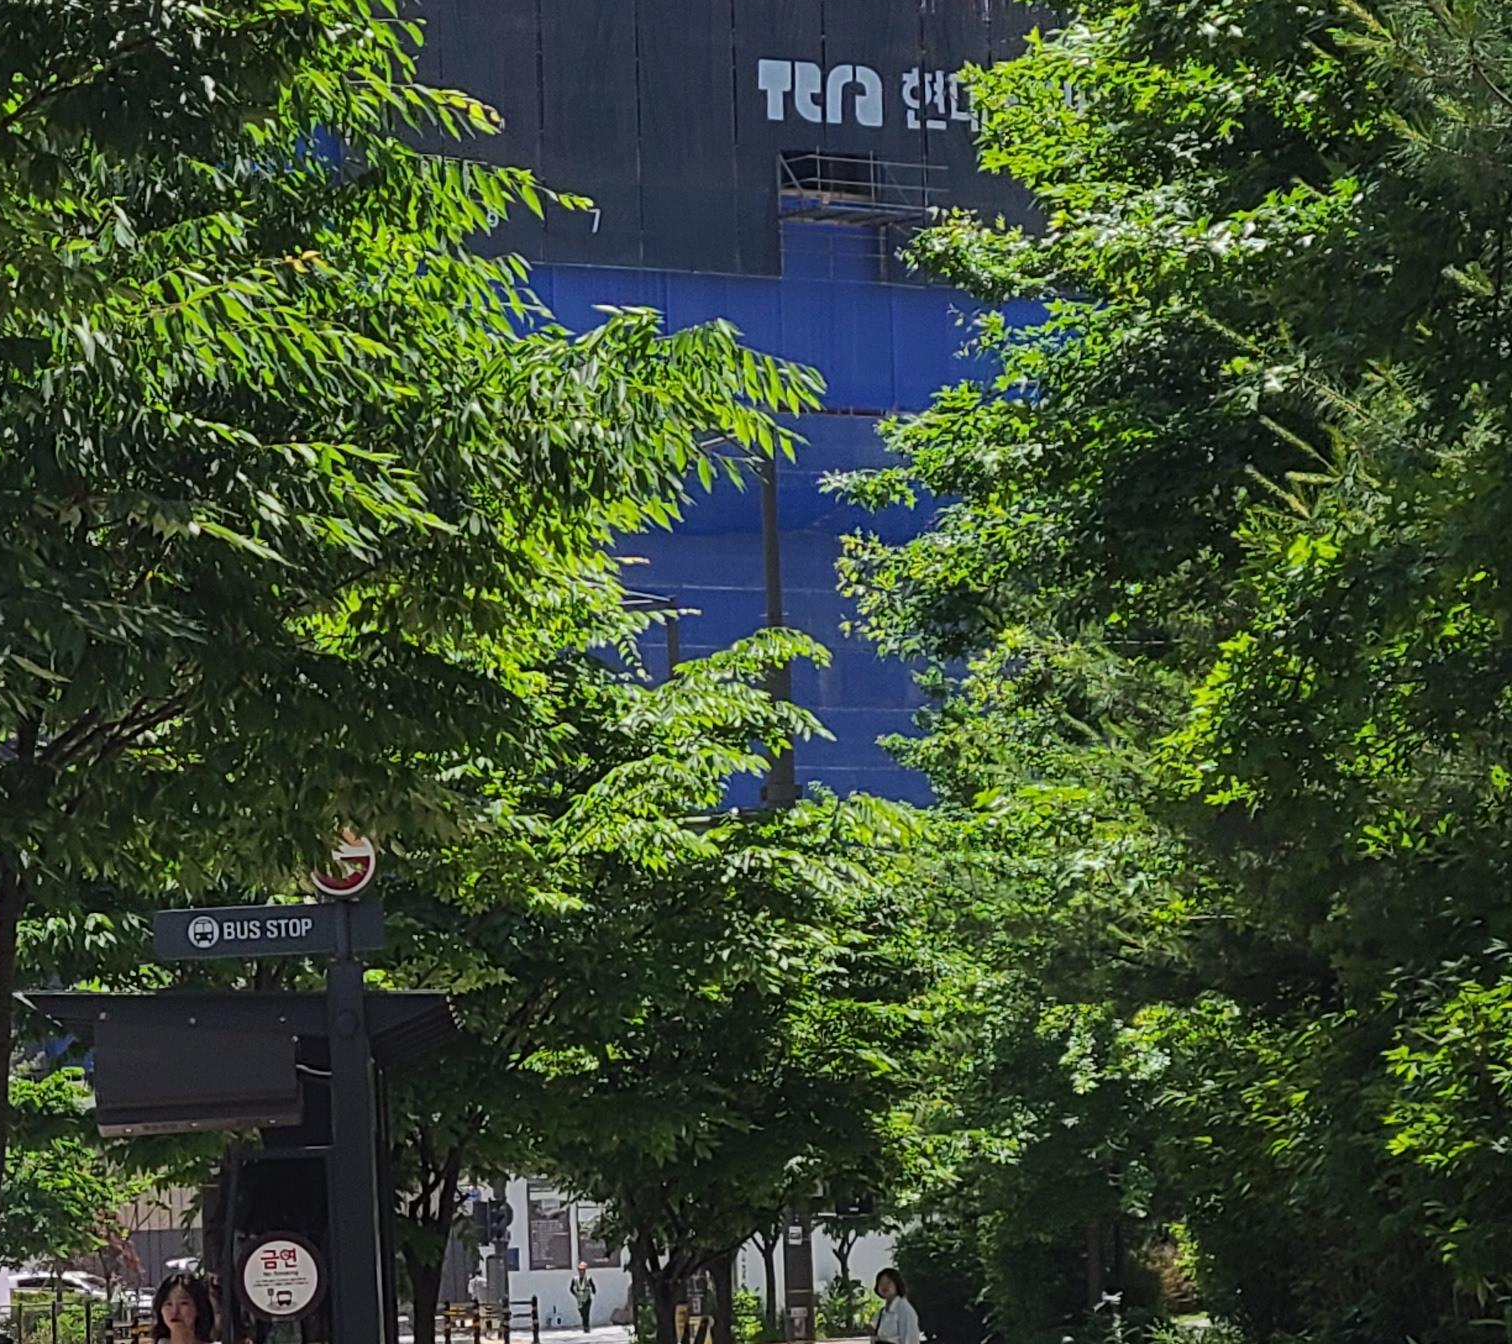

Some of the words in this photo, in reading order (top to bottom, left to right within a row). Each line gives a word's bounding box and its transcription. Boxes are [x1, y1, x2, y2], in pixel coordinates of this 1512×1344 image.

[223, 920, 261, 940] BUS
[266, 918, 313, 939] STOP
[261, 1248, 297, 1269] 금연
